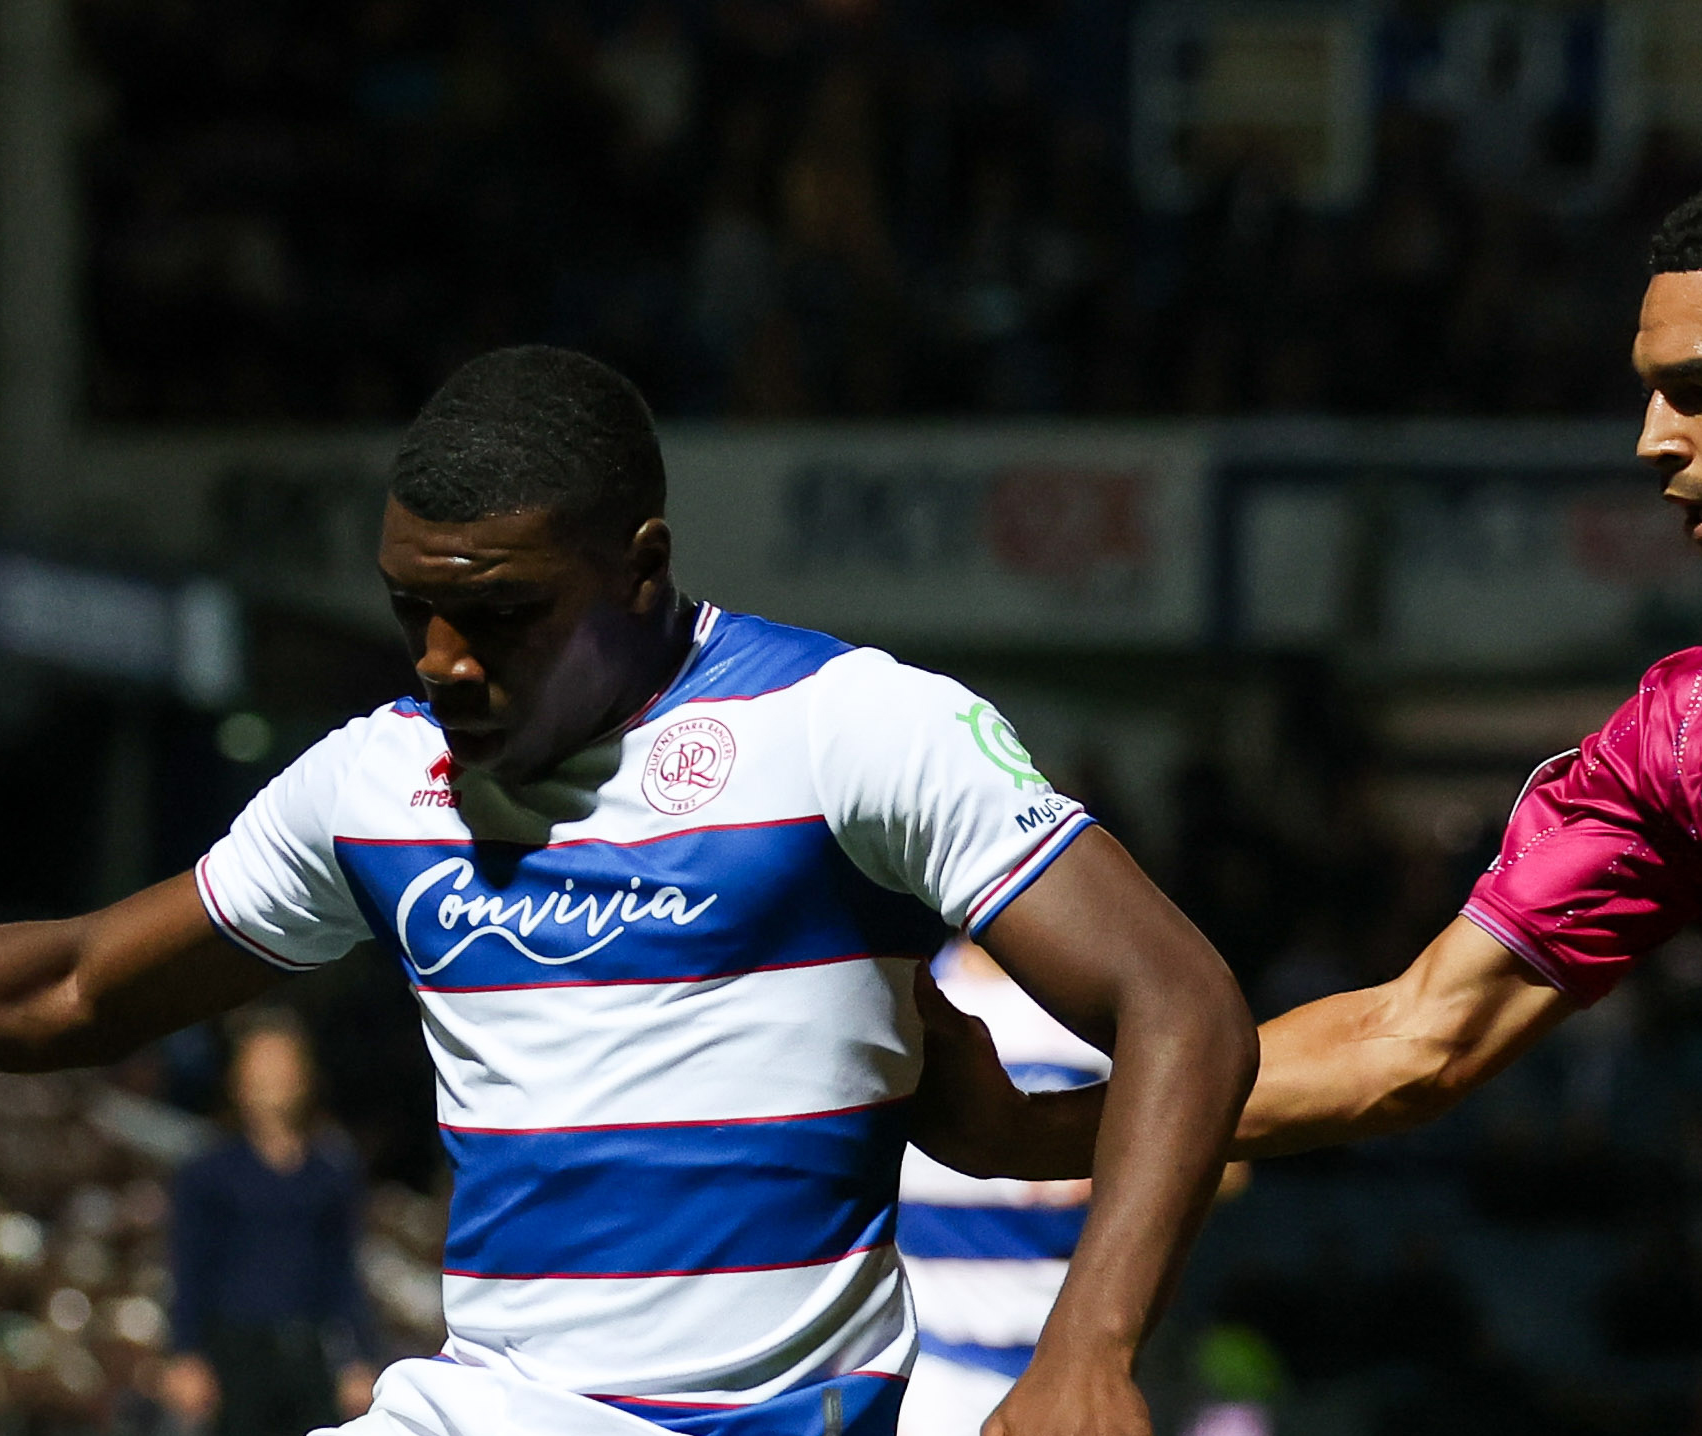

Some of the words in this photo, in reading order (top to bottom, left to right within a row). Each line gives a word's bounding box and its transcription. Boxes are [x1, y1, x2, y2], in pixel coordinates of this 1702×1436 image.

[677, 722, 704, 733] PARK
[707, 722, 732, 761] RANGERS
[398, 857, 718, 976] Convivia
